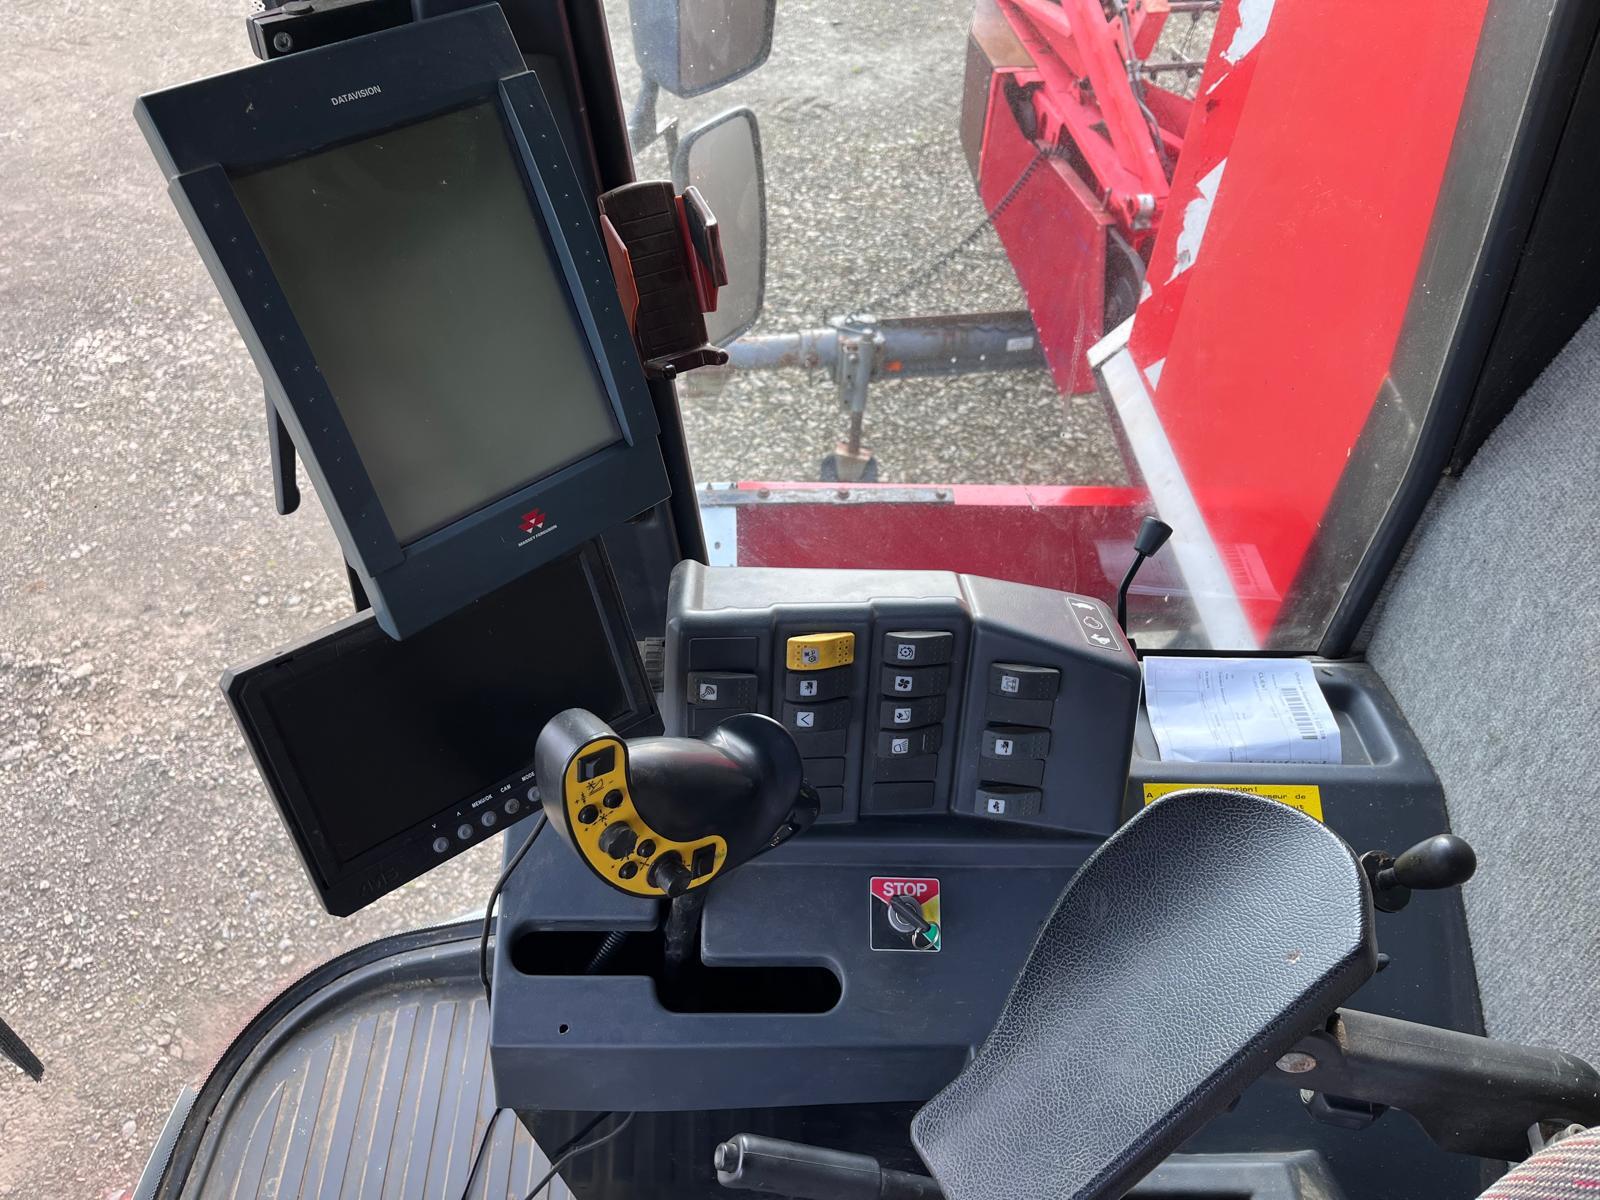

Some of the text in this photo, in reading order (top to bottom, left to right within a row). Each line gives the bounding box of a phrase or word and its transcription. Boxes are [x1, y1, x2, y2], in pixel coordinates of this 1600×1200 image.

[331, 85, 381, 105] DATAVISION
[500, 783, 511, 793] CAM
[521, 771, 535, 782] MODE
[883, 881, 928, 897] STOP
